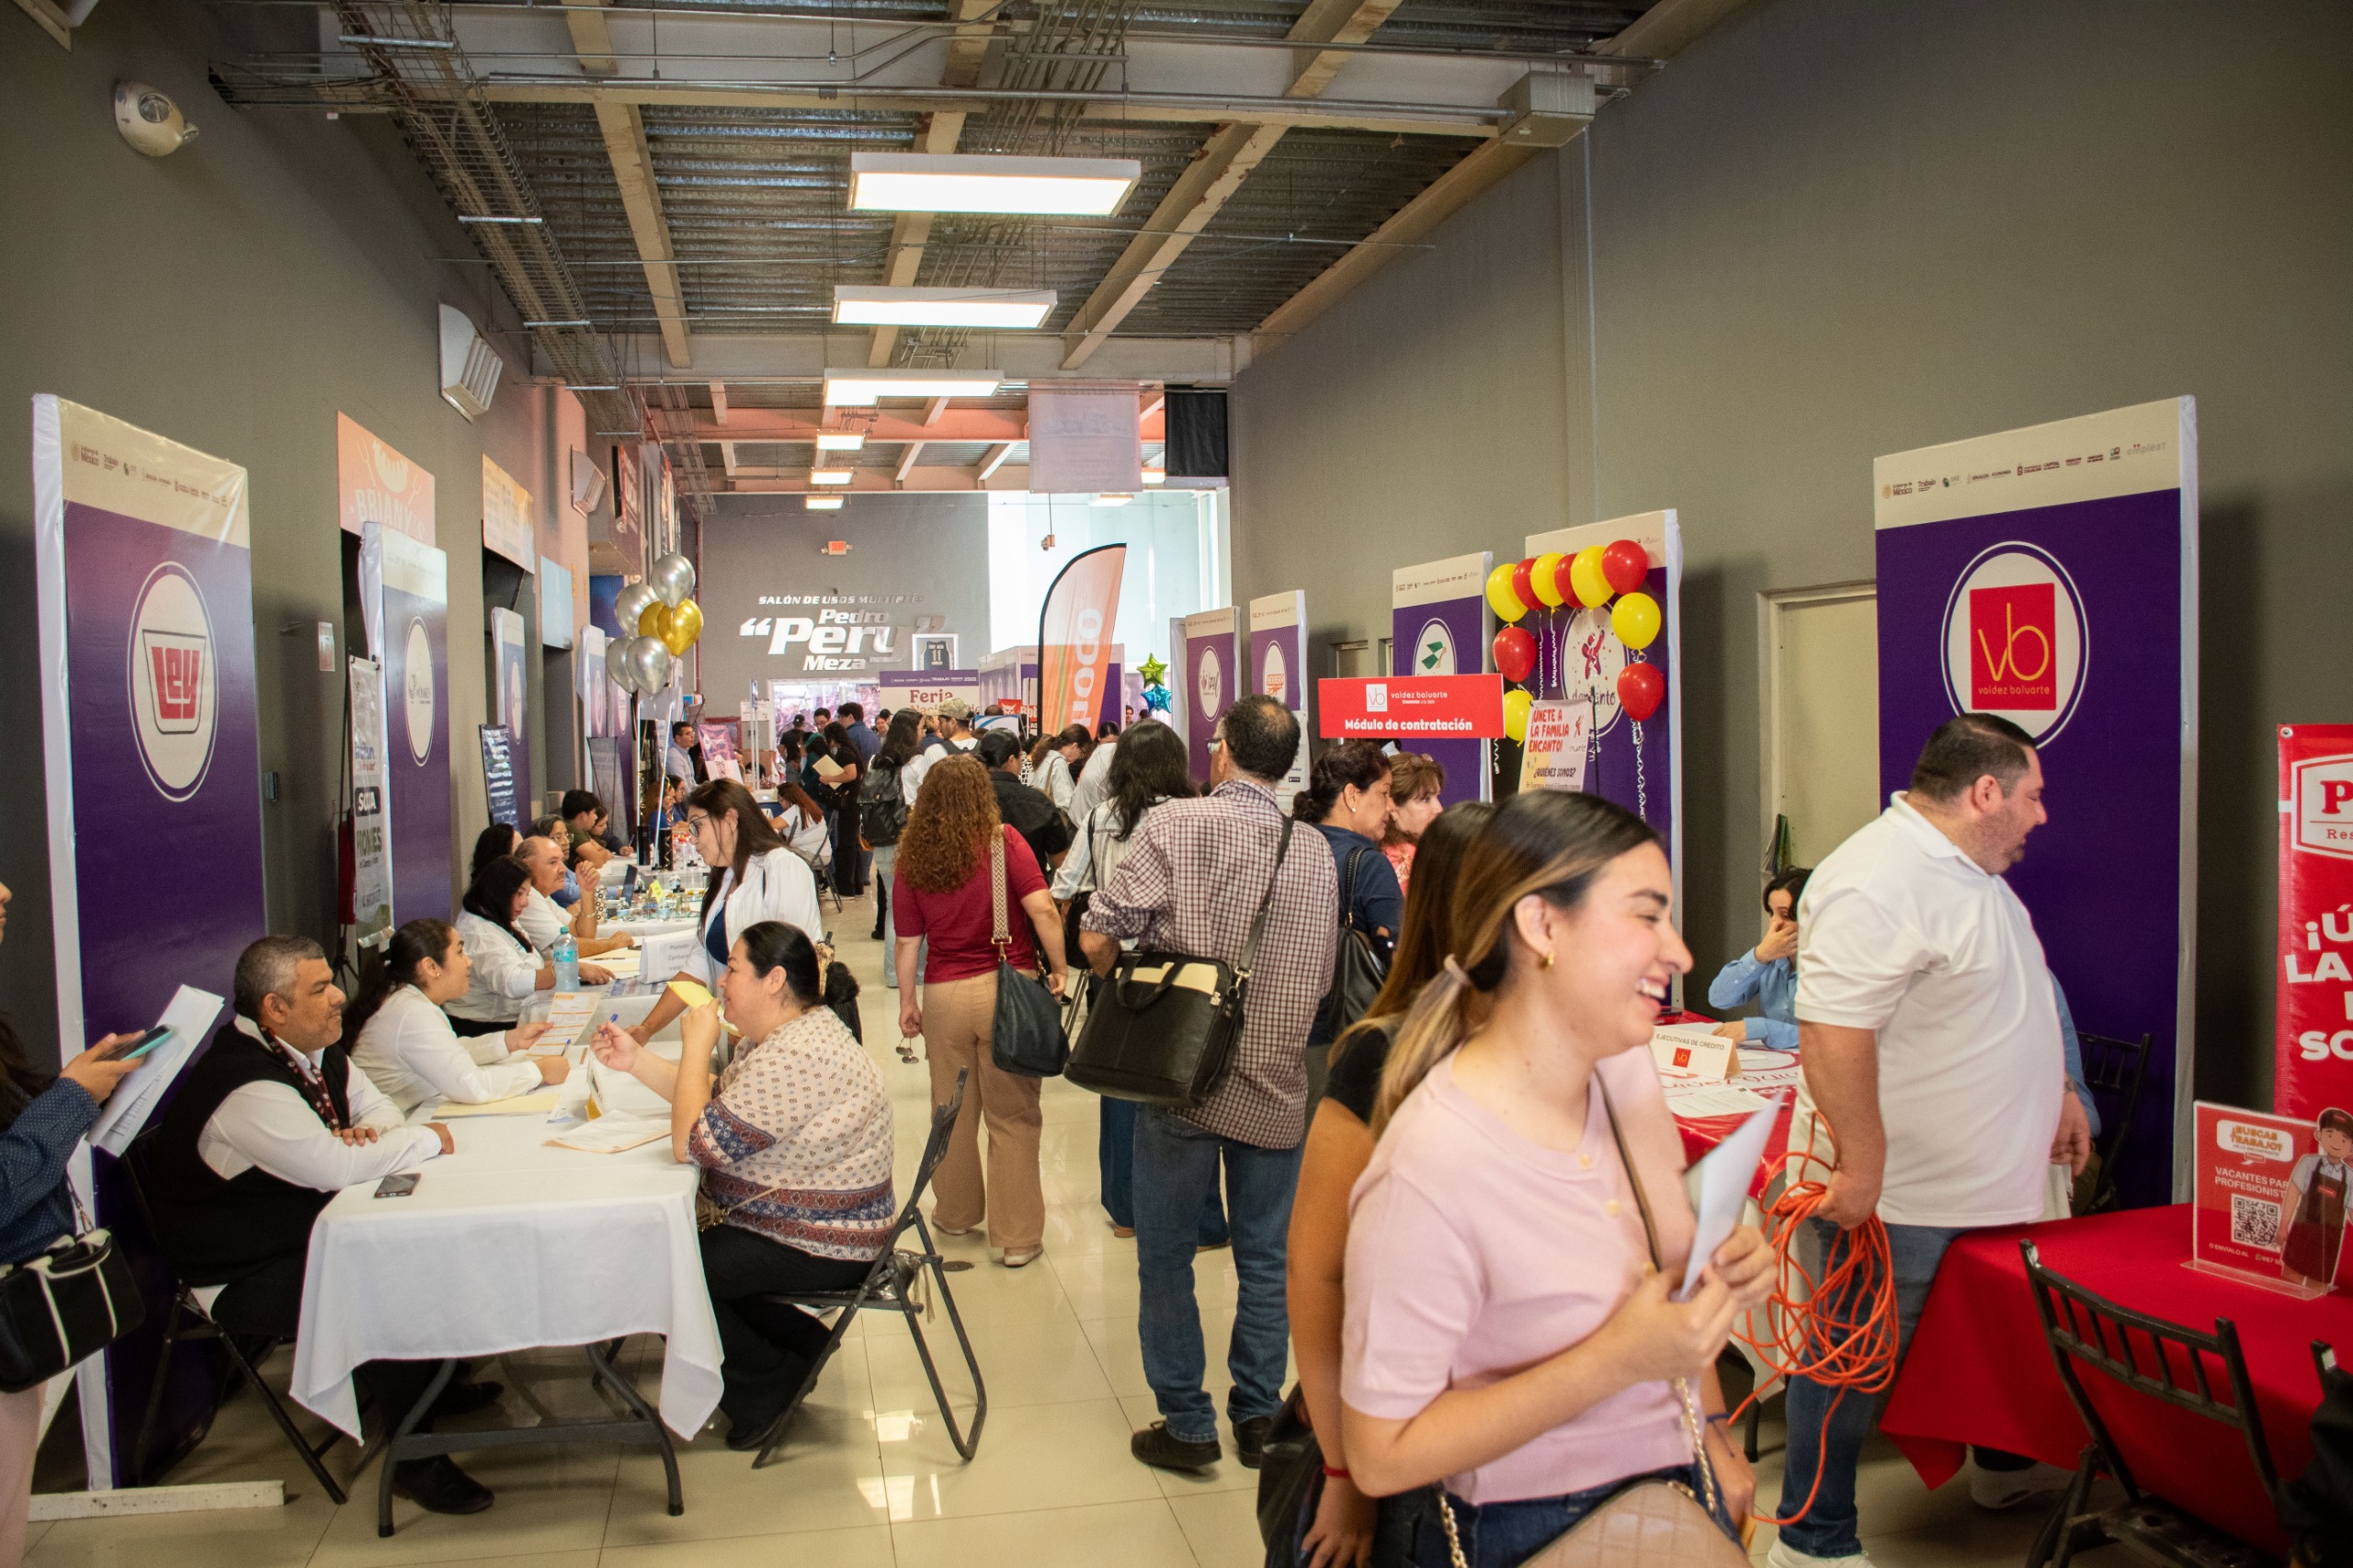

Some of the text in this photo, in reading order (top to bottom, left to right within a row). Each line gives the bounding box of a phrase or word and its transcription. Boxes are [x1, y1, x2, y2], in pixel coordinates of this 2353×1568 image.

[758, 595, 801, 605] SALÓN
[802, 596, 820, 605] DE
[823, 596, 855, 604] USOS
[819, 608, 890, 624] Pedro
[1978, 602, 2050, 681] vb
[802, 655, 867, 671] Meza
[910, 689, 953, 703] Feria
[1391, 690, 1449, 699] valdez baluarte
[1978, 685, 2050, 695] valdez baluarte
[1558, 709, 1563, 720] A
[1345, 718, 1472, 731] Módulo de contratación
[1530, 724, 1569, 738] LA FAMILIA
[1529, 739, 1563, 753] ENCANTO!
[2284, 952, 2353, 983] LA
[1655, 1034, 1689, 1045] EJECUTIVAS
[1699, 1040, 1725, 1051] CRÉDITO
[2214, 1166, 2289, 1187] VACANTES PAR
[2214, 1176, 2287, 1199] PROFESIONIST
